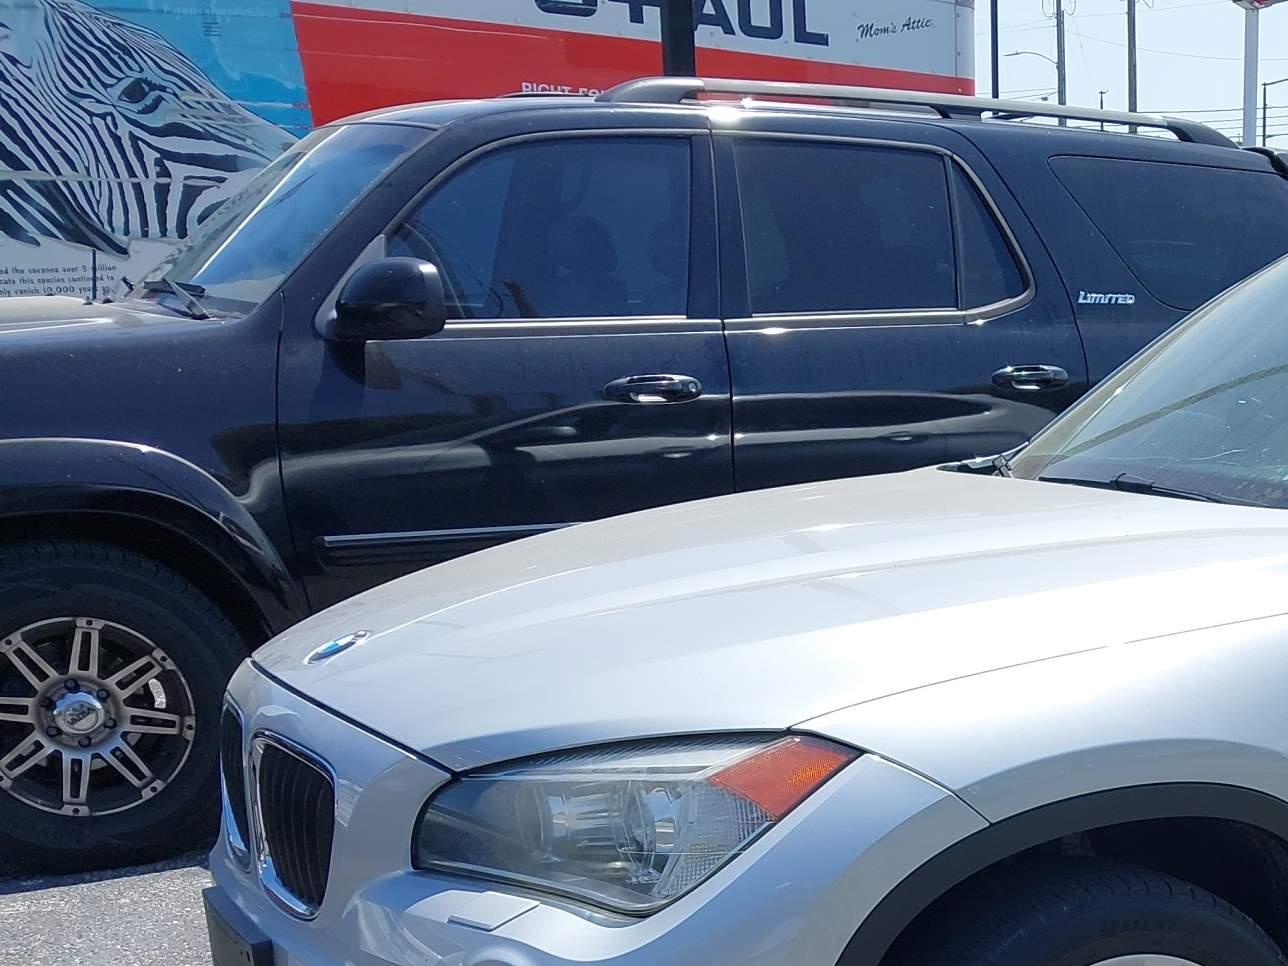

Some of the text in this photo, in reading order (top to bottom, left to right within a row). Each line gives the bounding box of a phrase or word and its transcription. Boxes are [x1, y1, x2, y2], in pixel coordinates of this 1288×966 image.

[857, 16, 932, 38] Mom's Attic
[19, 276, 35, 285] this
[38, 277, 65, 286] species
[14, 286, 40, 295] vanish
